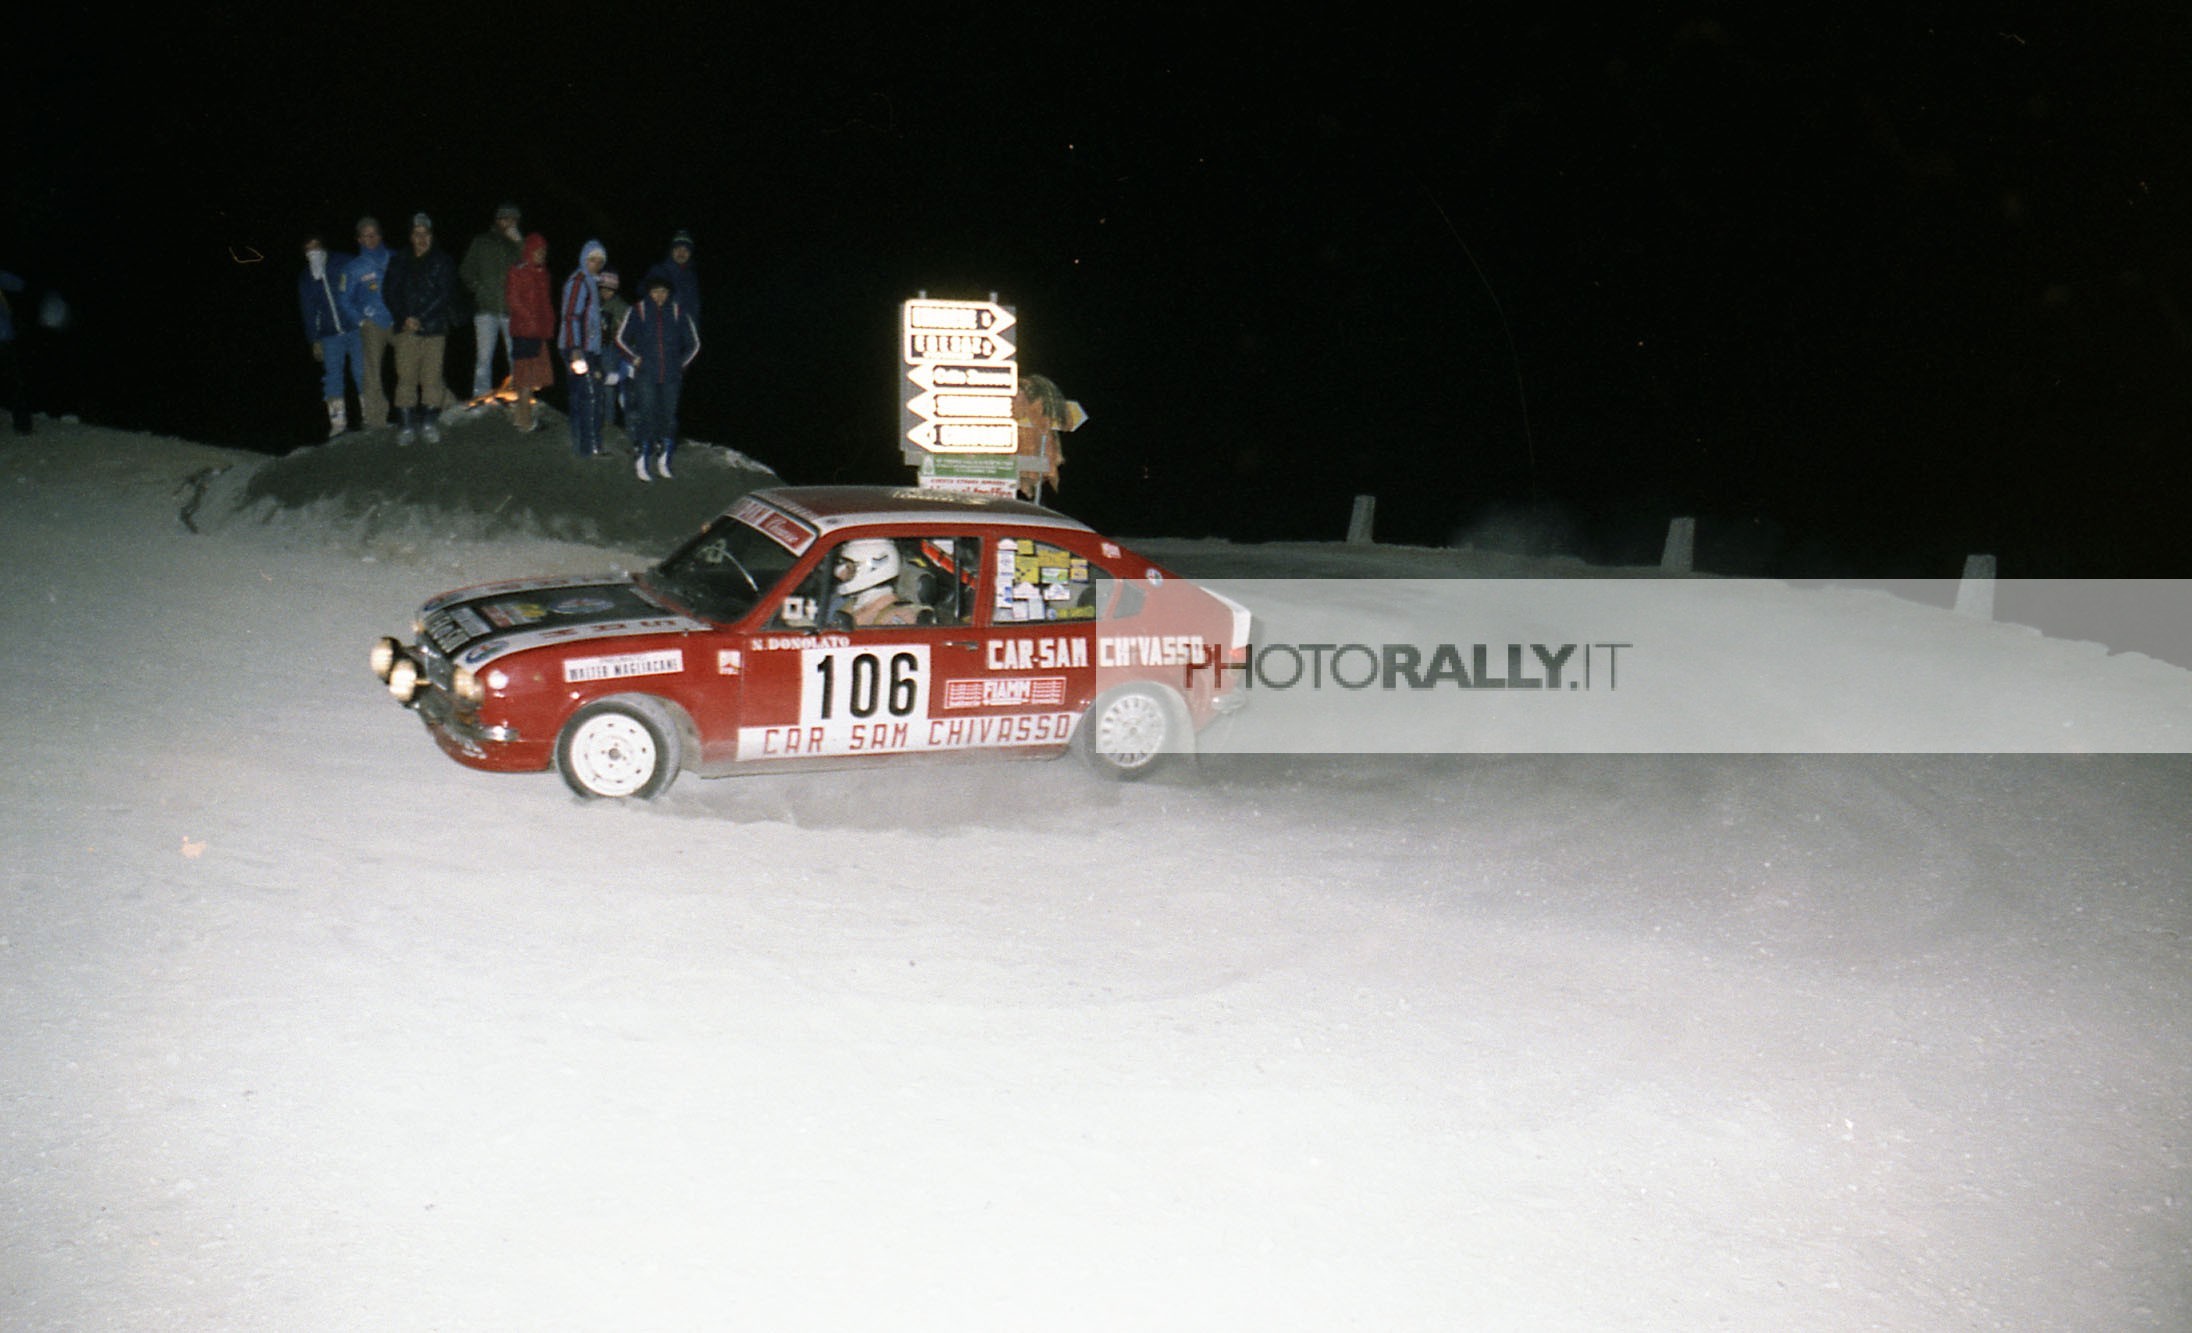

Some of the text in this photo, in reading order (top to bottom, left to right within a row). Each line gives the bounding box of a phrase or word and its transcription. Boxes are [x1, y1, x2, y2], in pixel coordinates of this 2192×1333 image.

[987, 637, 1088, 670] CAR-SAM
[816, 652, 919, 719] 106
[983, 681, 1031, 699] FIAMM
[763, 714, 1071, 754] CAR SAM CHIVASSO
